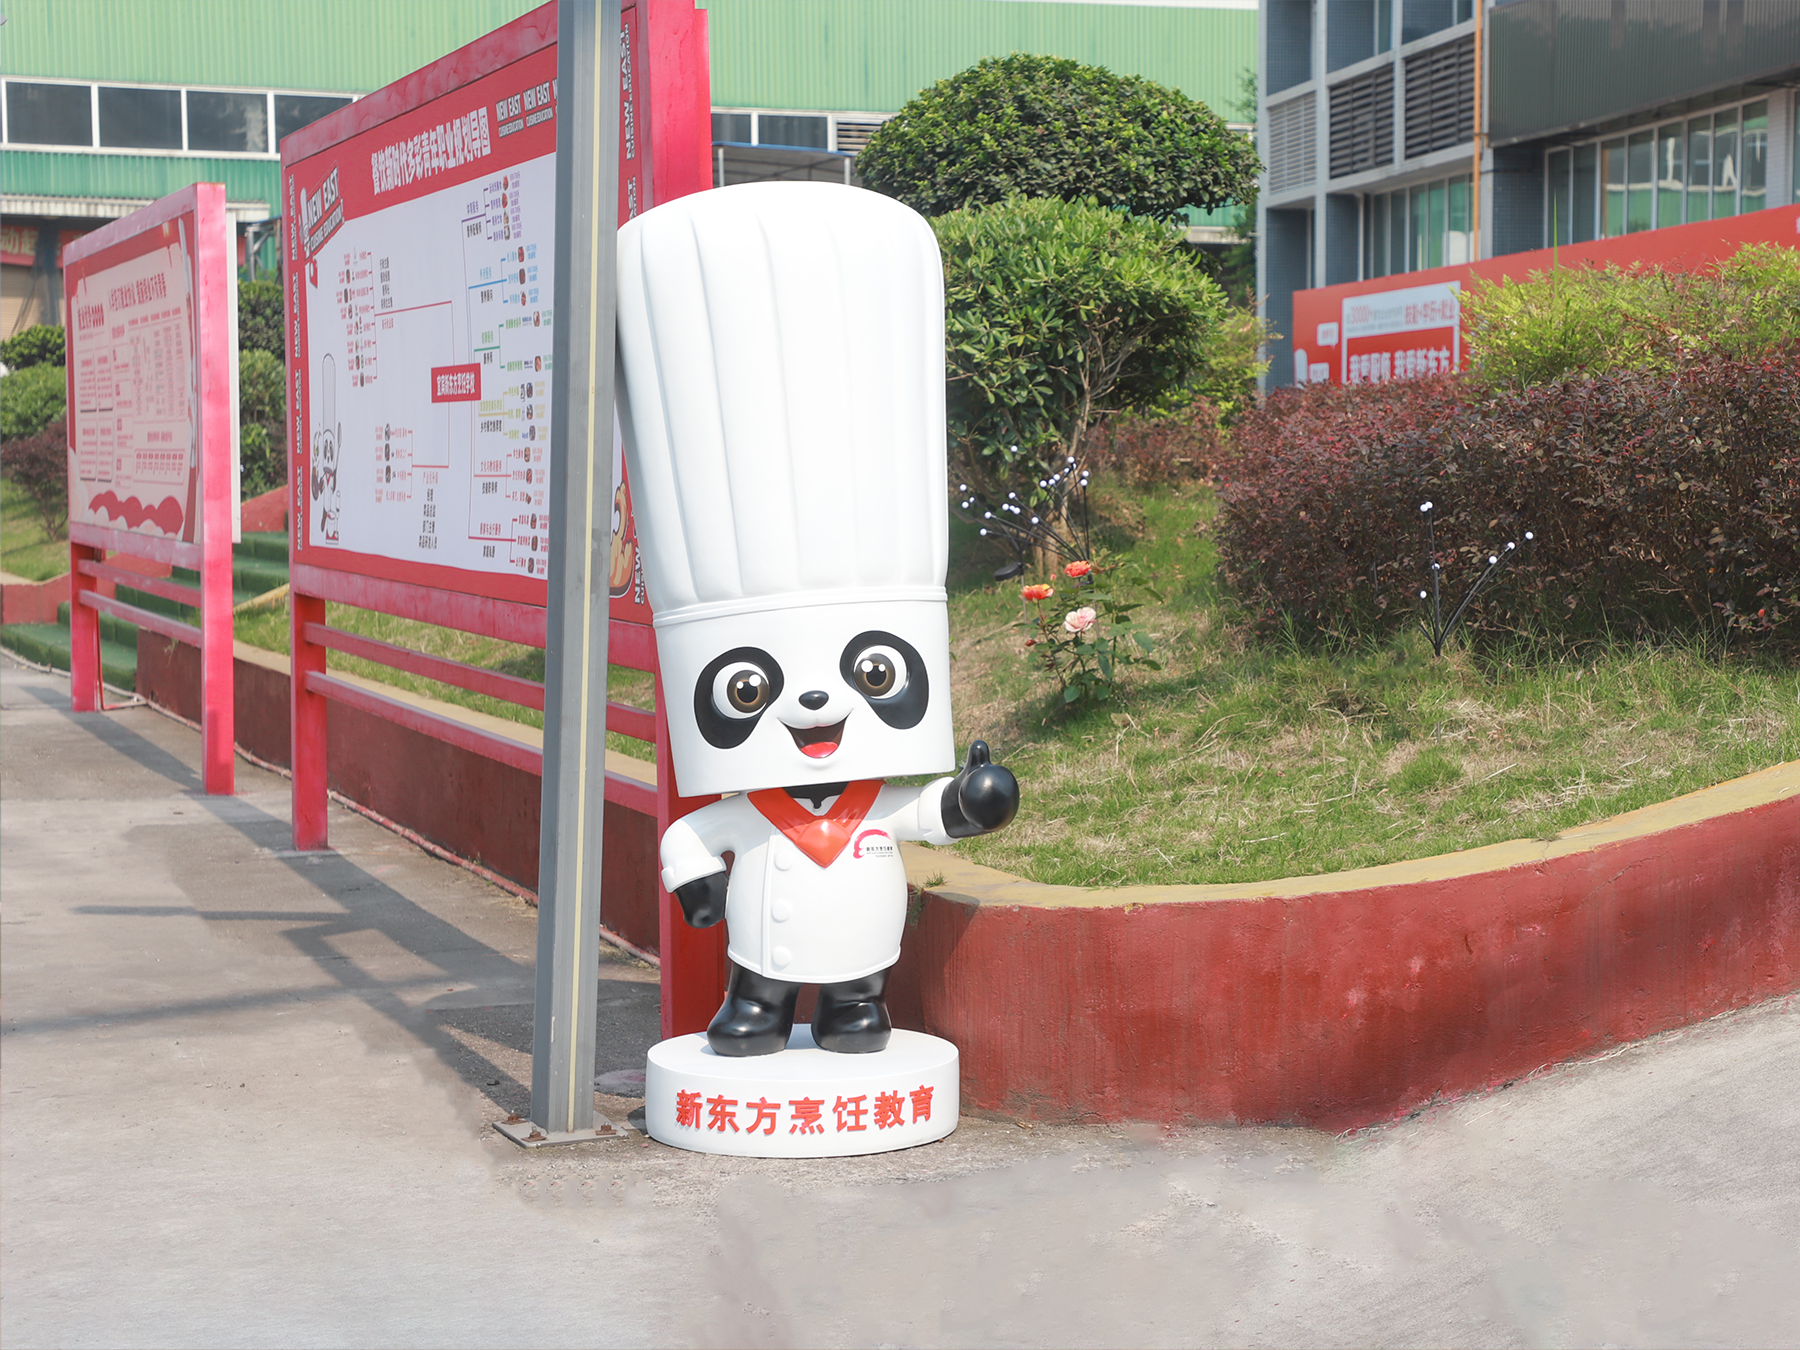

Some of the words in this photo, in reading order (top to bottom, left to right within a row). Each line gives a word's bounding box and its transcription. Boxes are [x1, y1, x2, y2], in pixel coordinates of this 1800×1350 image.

[620, 30, 629, 91] EAST
[496, 99, 508, 122] NEW
[508, 93, 521, 118] EAST
[523, 87, 536, 111] NEW
[536, 81, 550, 107] EAST
[624, 100, 632, 160] NEW
[307, 187, 323, 231] NEW
[322, 166, 339, 212] EAST
[676, 1084, 935, 1135] 新东方烹饪教育
